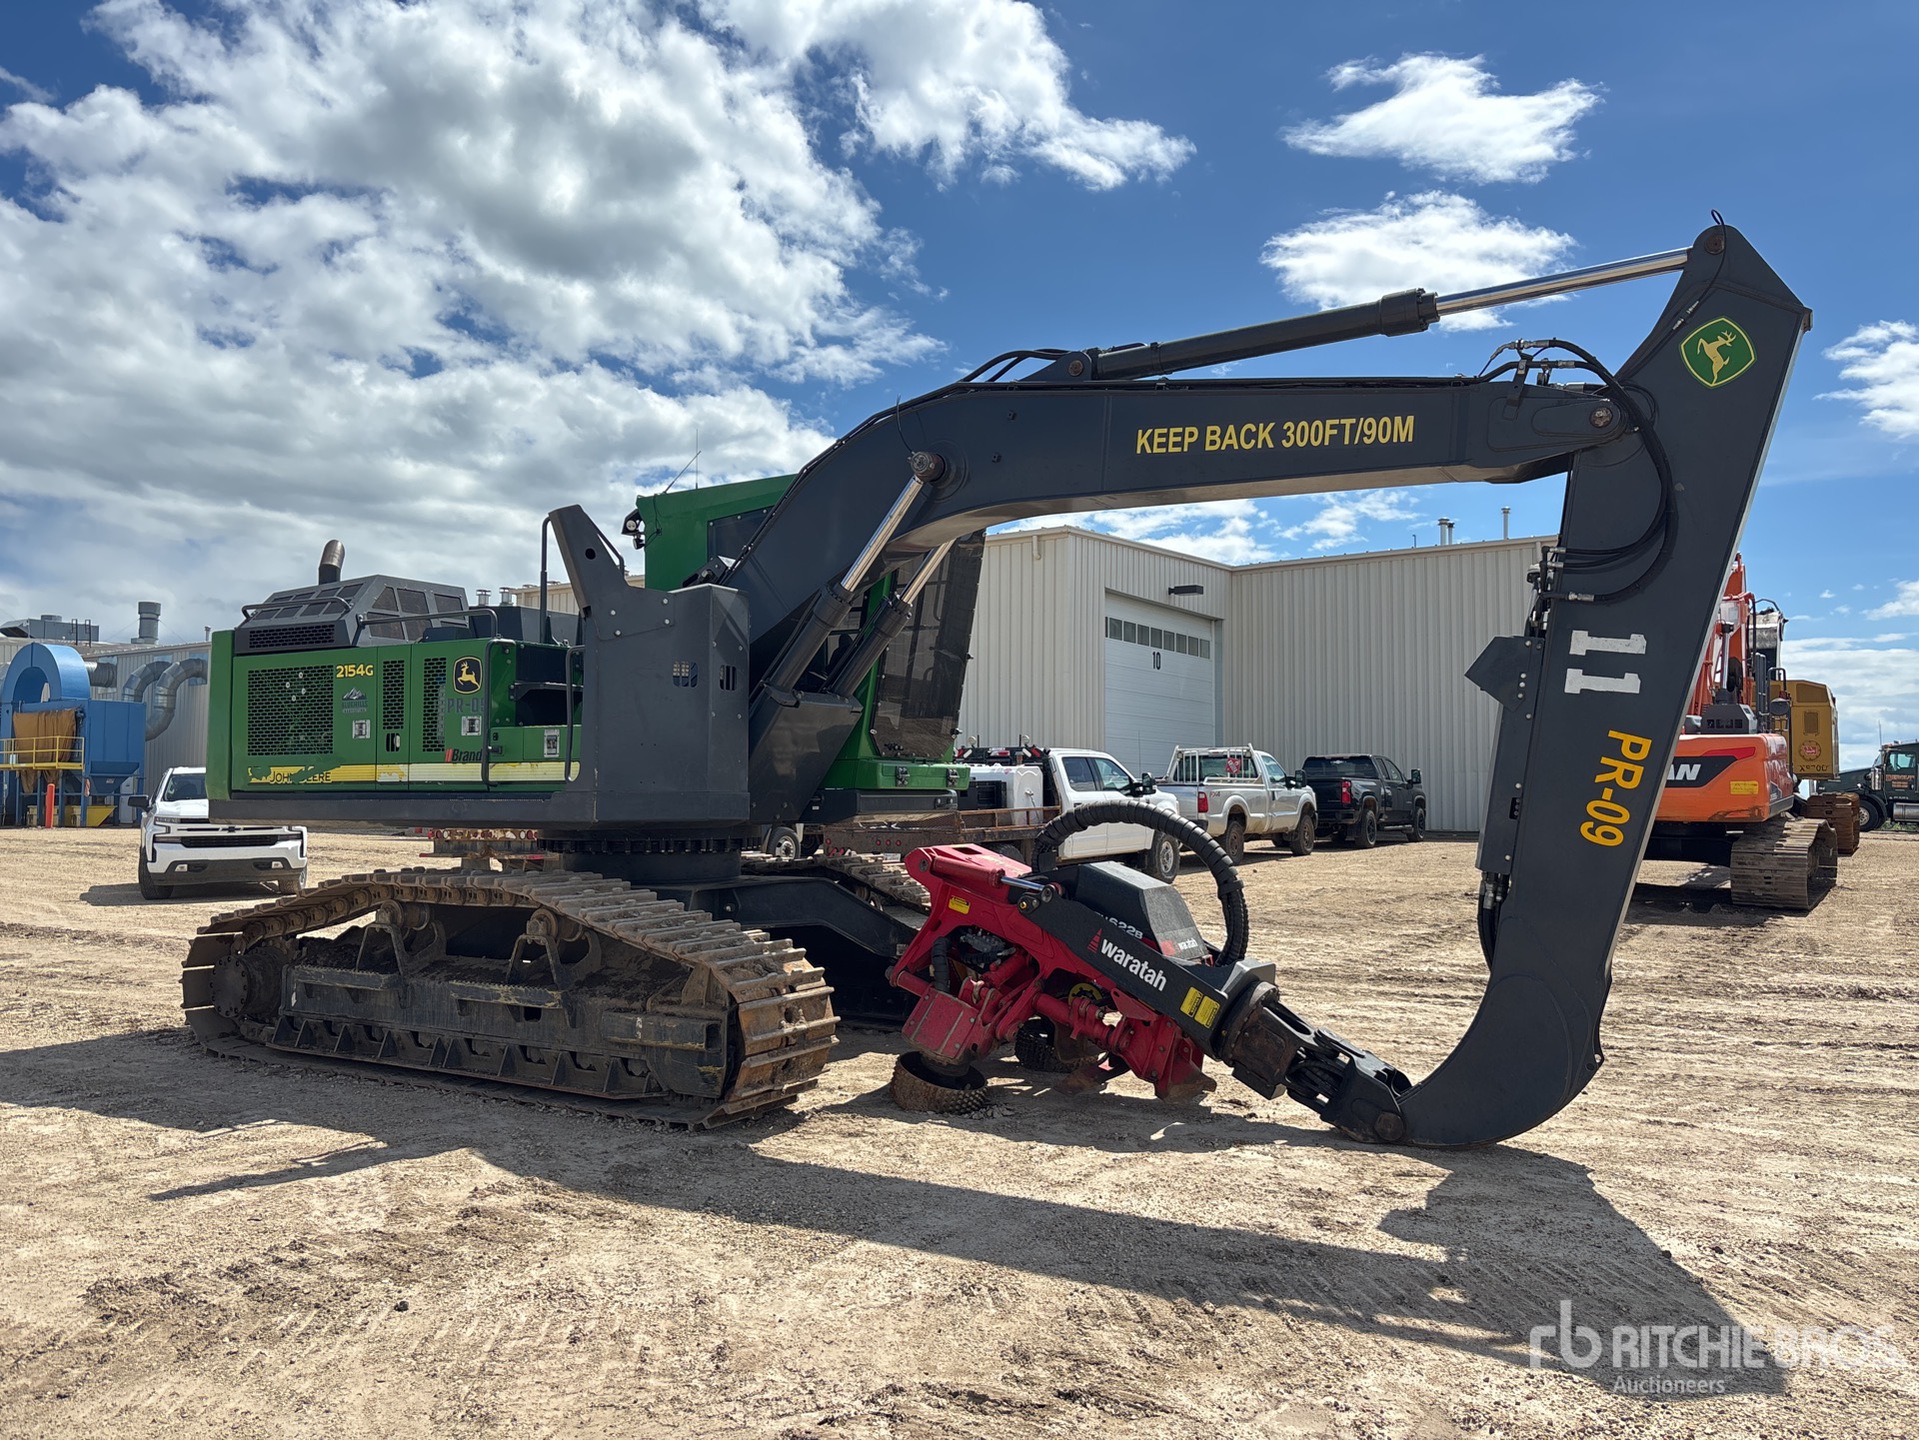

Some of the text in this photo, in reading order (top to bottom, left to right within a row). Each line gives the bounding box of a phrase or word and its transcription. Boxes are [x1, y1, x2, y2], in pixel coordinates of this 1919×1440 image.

[1136, 415, 1415, 454] KEEP BACK 300FT/90M
[336, 664, 374, 678] 2154G
[1152, 651, 1161, 670] 10
[1564, 629, 1647, 694] 11
[452, 749, 483, 762] Brand
[299, 771, 332, 783] EERE
[1579, 729, 1652, 847] PR-09
[1100, 938, 1167, 992] waratah
